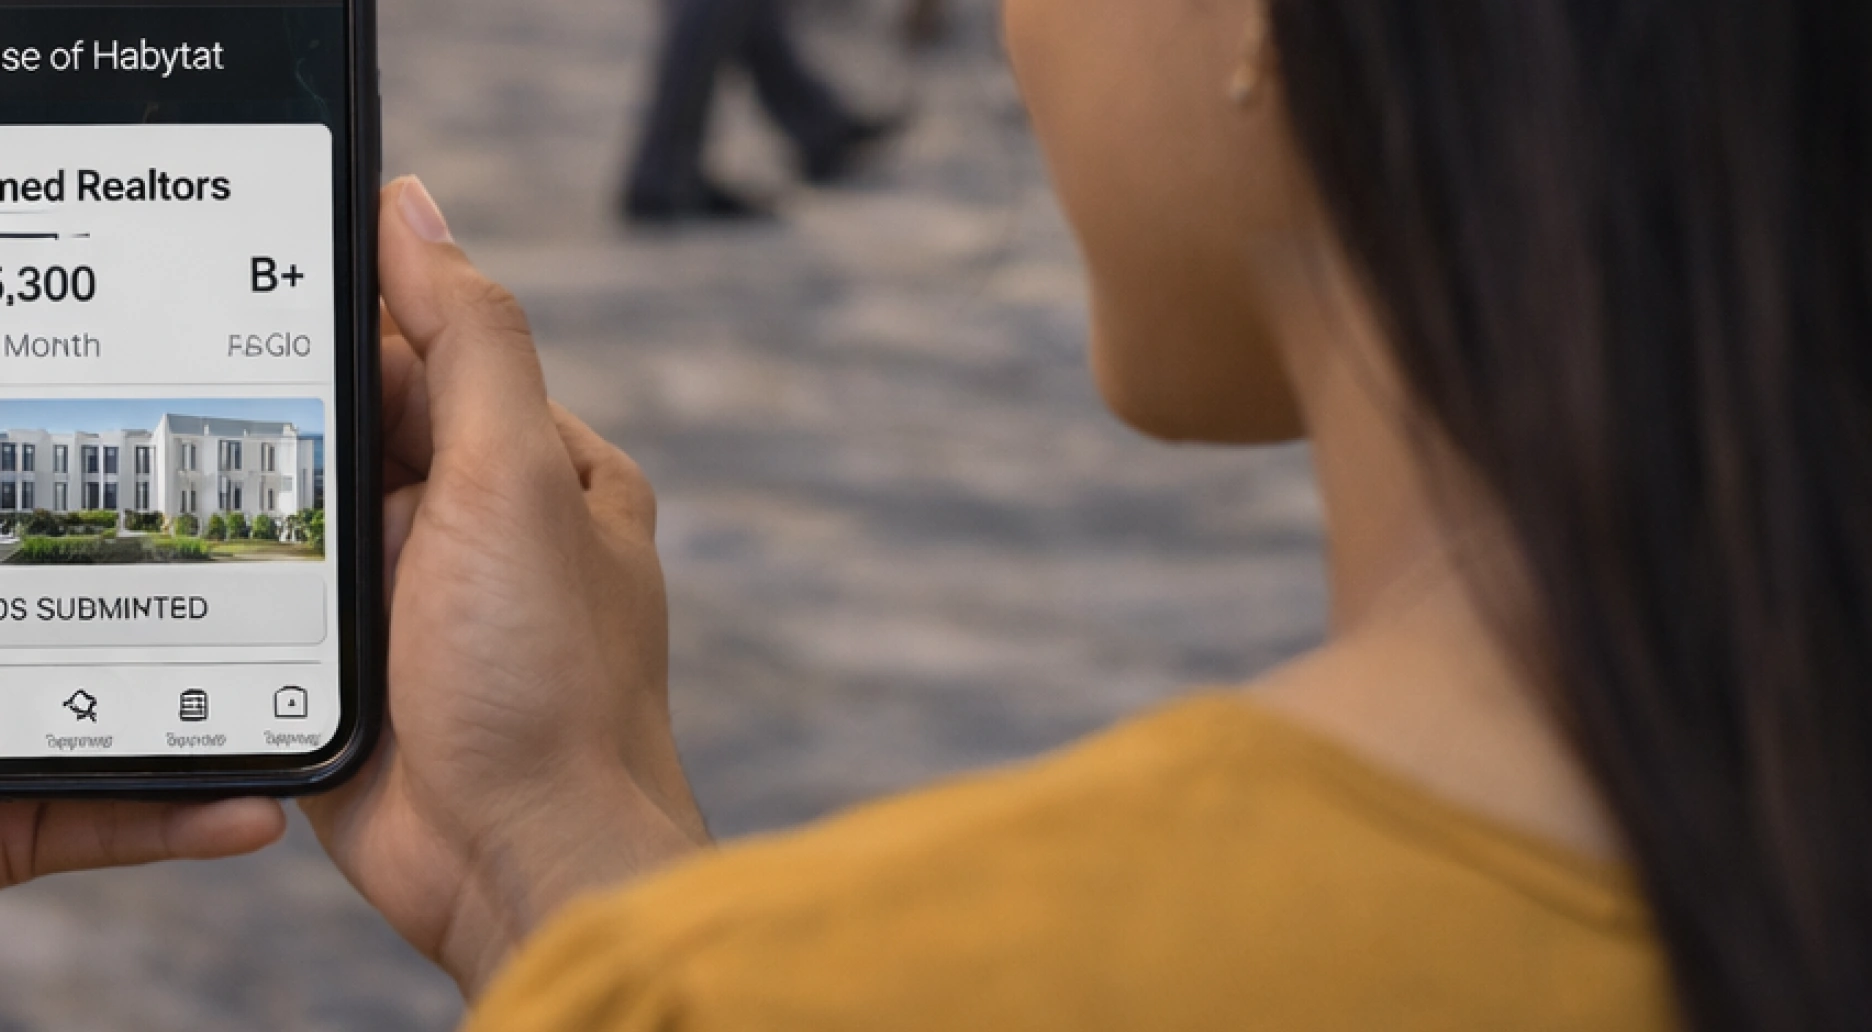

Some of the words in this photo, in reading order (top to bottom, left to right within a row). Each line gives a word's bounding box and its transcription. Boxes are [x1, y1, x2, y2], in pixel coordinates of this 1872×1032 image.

[50, 40, 84, 71] of
[93, 38, 225, 79] Habytat
[78, 168, 232, 202] Realtors
[250, 256, 304, 293] B+
[4, 333, 101, 358] Month
